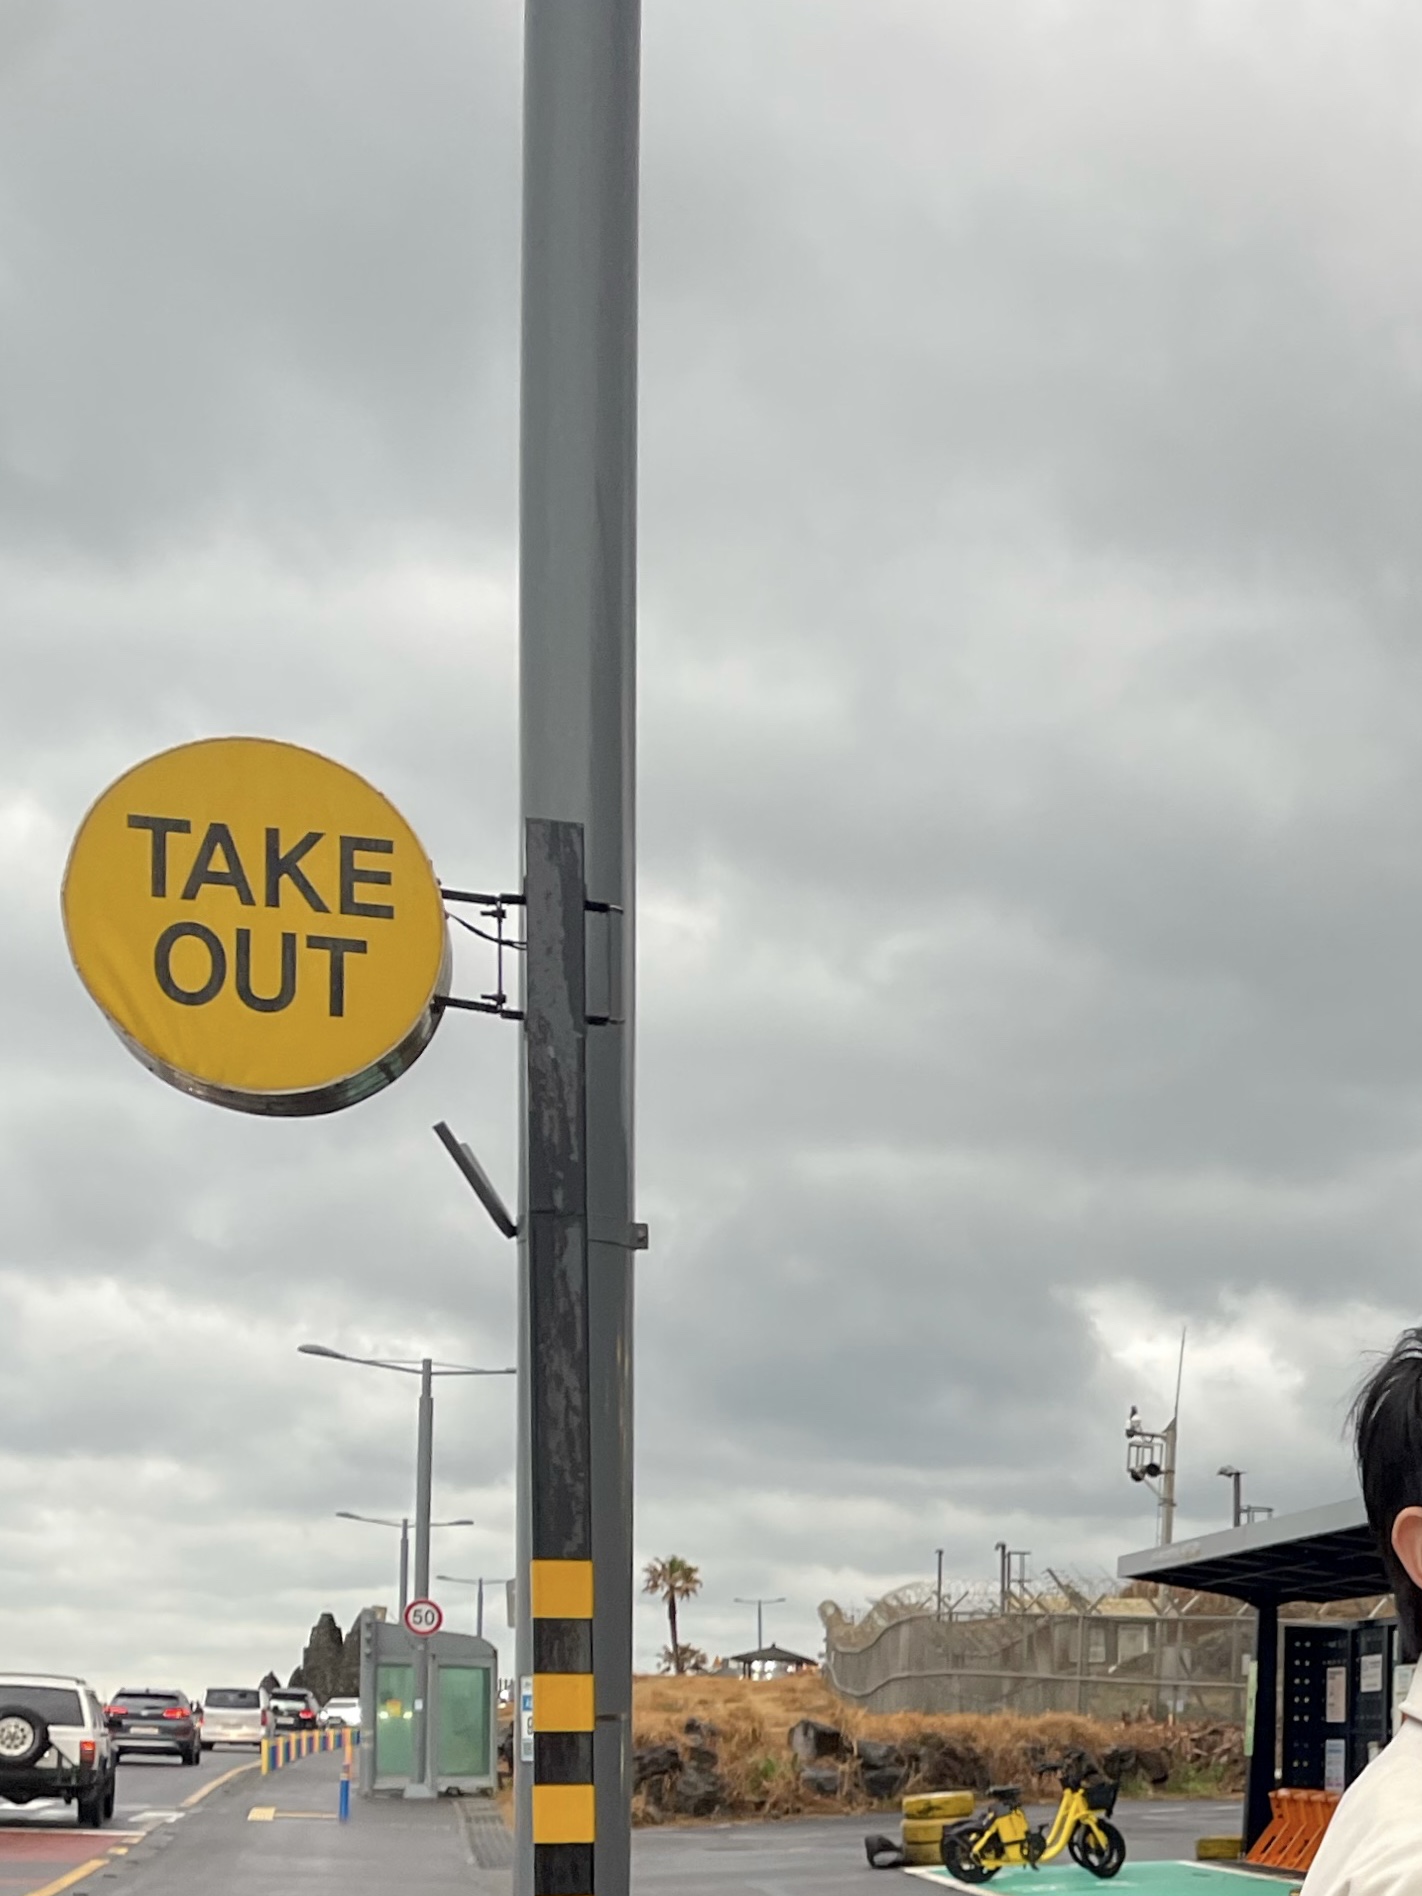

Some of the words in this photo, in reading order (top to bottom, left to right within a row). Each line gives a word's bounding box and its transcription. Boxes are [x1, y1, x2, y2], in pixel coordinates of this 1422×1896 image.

[127, 814, 394, 919] TAKE
[154, 921, 368, 1018] OUT
[412, 1608, 435, 1626] 50
